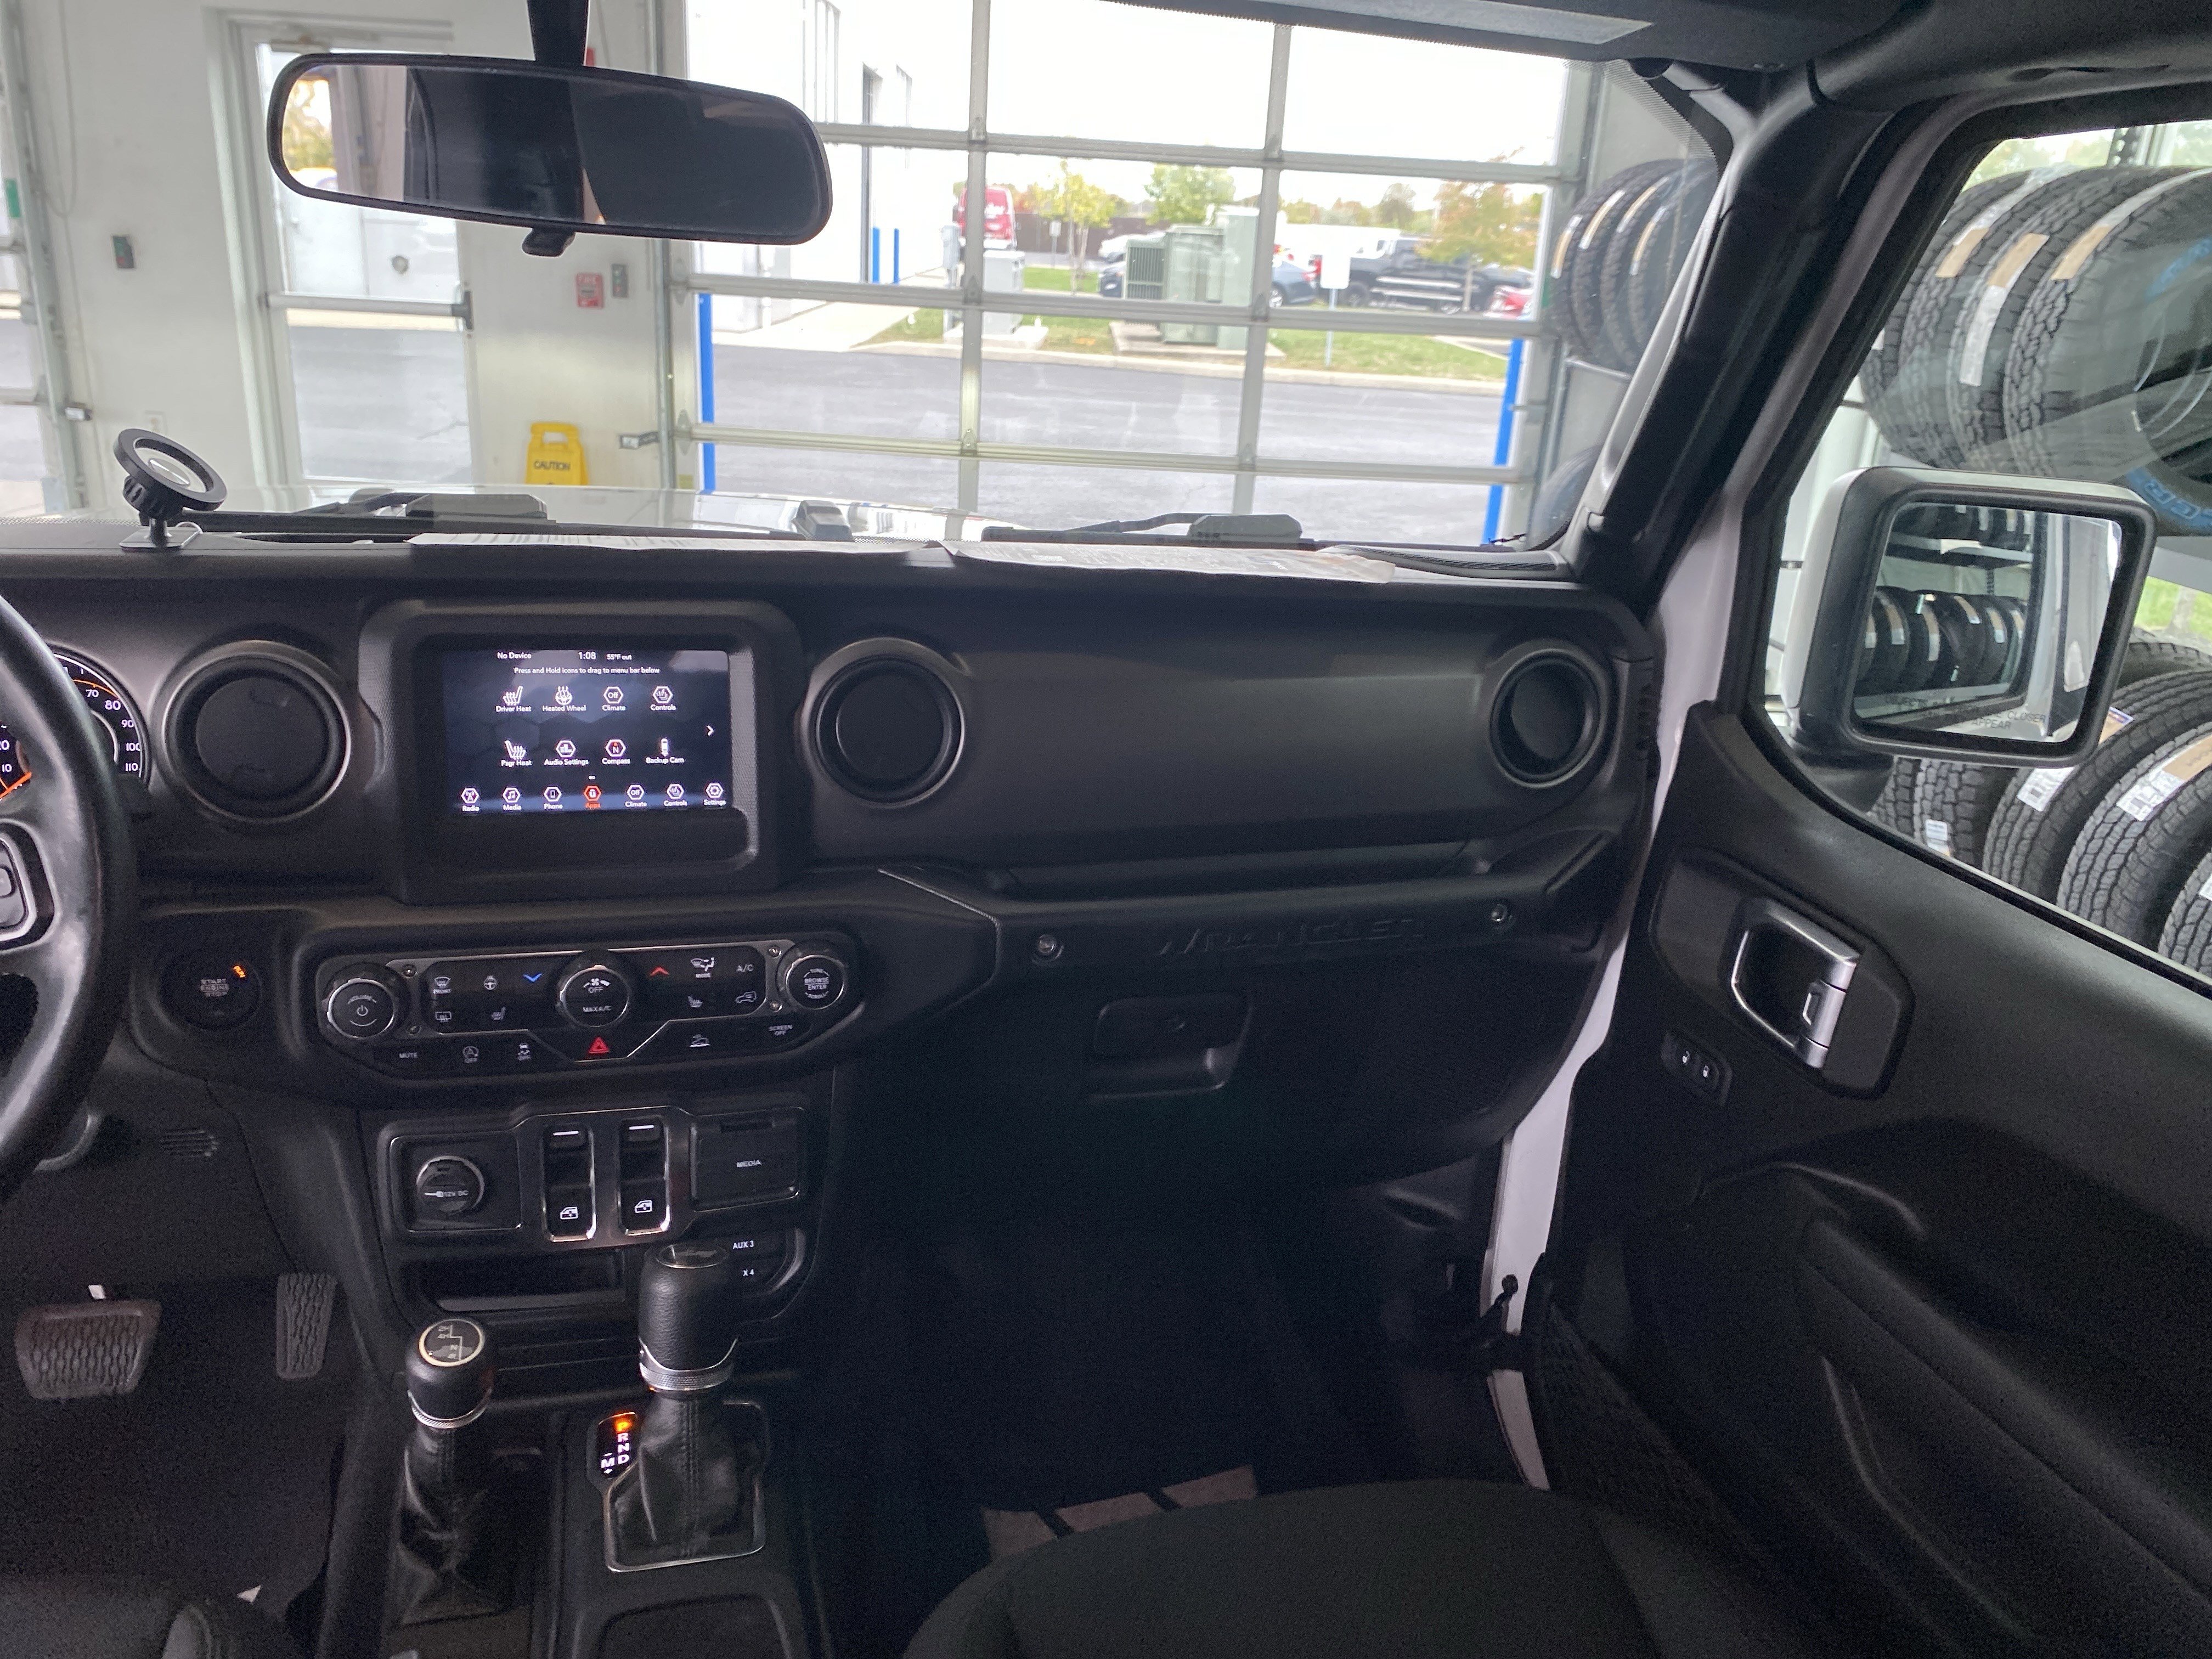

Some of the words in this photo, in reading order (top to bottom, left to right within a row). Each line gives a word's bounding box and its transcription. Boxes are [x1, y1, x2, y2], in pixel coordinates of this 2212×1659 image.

[534, 460, 571, 471] CAUTION
[578, 651, 597, 660] 1:08
[587, 667, 602, 675] drag
[86, 689, 99, 698] 70
[104, 700, 121, 710] 80
[2007, 710, 2046, 723] CLOSER
[121, 719, 134, 728] 90
[1971, 719, 2012, 730] APPEAR
[0, 740, 10, 751] 0
[2, 764, 12, 772] 10
[125, 763, 138, 771] 110
[703, 799, 726, 807] Settings
[737, 964, 754, 973] A/C
[737, 1159, 762, 1168] MEDIA
[732, 1242, 748, 1250] AUX
[617, 1420, 629, 1432] P
[618, 1432, 629, 1442] R
[618, 1442, 630, 1453] N
[601, 1457, 615, 1469] M
[618, 1454, 630, 1464] D
